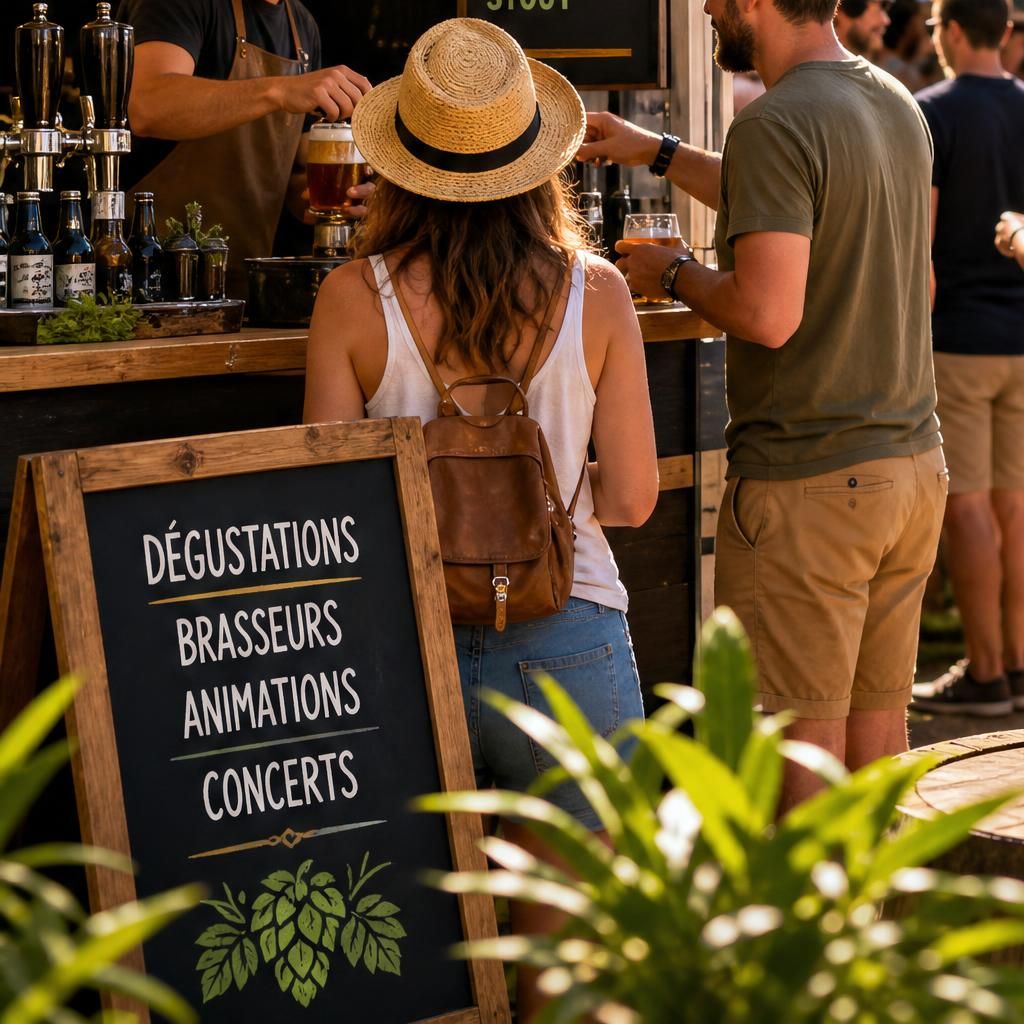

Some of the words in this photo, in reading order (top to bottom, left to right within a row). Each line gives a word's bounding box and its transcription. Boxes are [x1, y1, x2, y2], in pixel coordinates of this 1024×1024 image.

[143, 515, 360, 586] DÉGUSTATIONS
[176, 599, 343, 667] BRASSEURS
[183, 667, 361, 740] ANIMATIONS
[202, 749, 359, 822] CONCERTS
